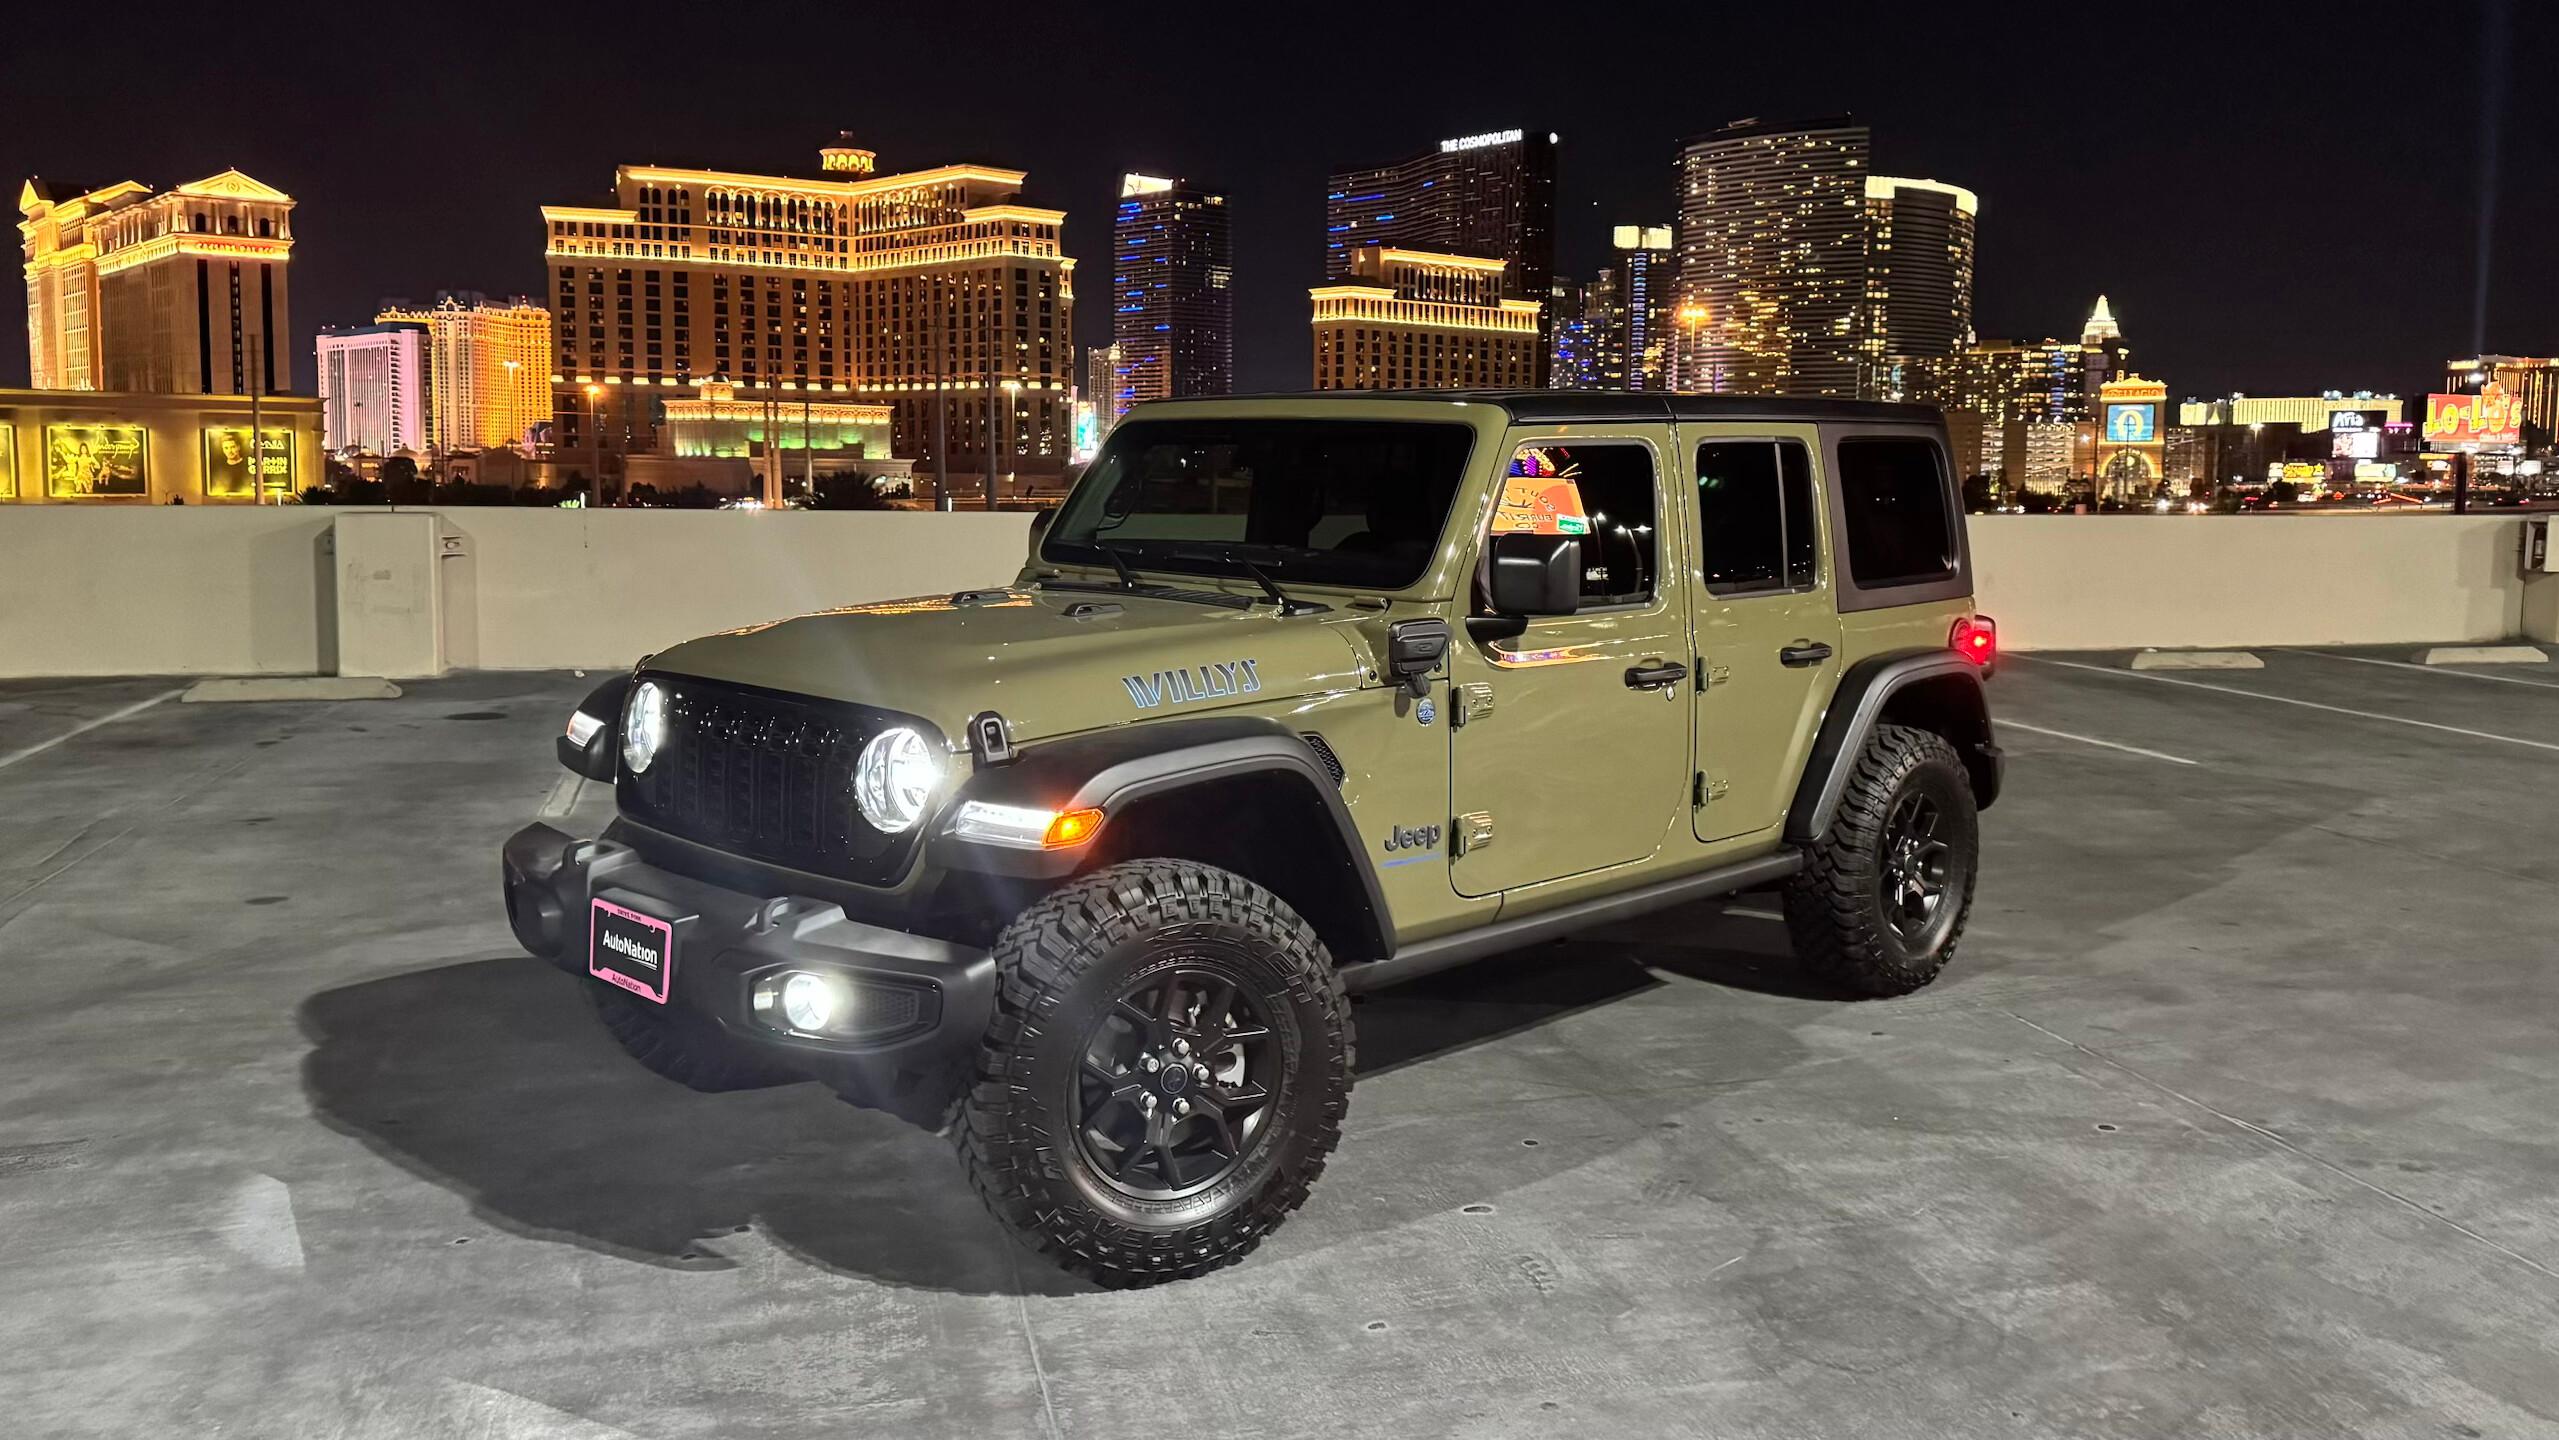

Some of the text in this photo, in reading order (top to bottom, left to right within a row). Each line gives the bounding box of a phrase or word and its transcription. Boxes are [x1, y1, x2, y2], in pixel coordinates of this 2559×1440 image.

[1441, 129, 1522, 152] THE COSMOPOLITAN
[247, 456, 288, 466] MRTIN
[1121, 658, 1261, 709] WILLYS
[1384, 825, 1441, 852] Jeep
[602, 929, 658, 964] AutoNation
